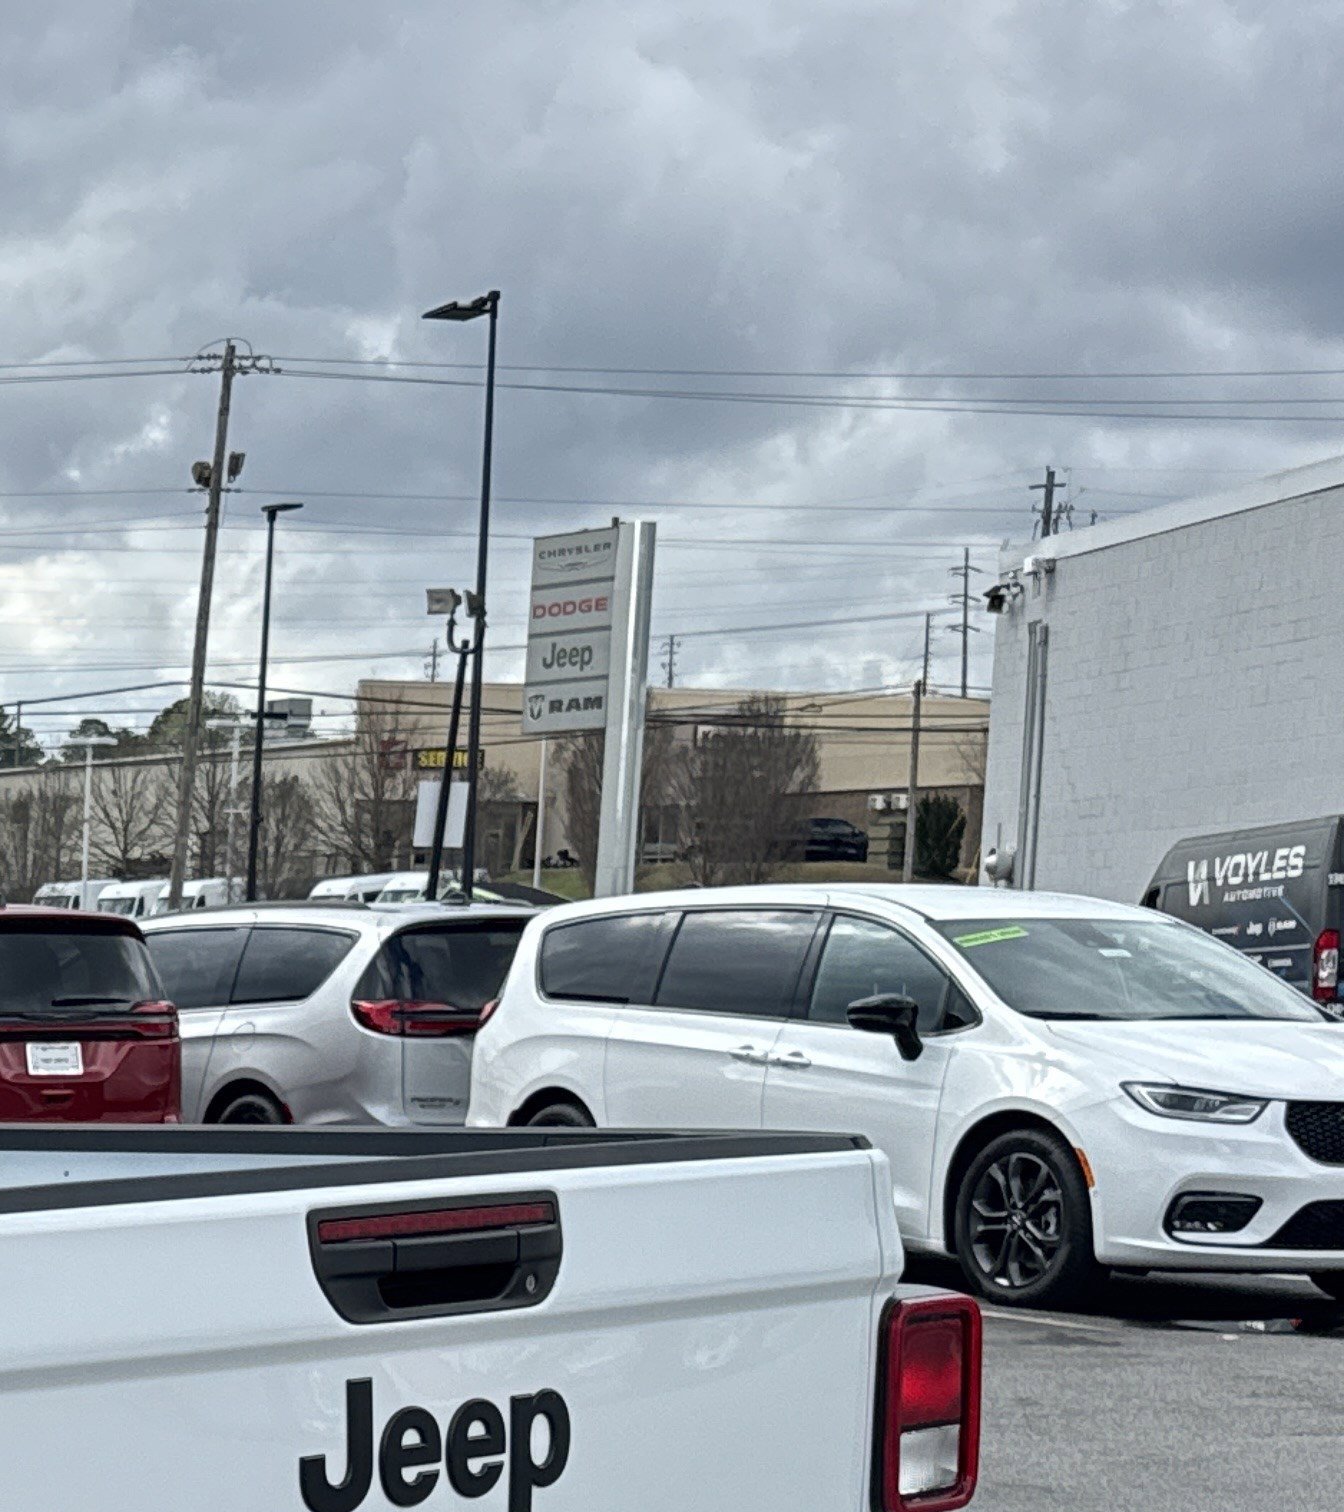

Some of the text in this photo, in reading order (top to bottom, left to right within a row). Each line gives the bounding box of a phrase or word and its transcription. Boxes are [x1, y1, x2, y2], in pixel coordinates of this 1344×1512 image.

[538, 542, 612, 560] CHRYSLER
[532, 597, 609, 620] DODGE
[542, 642, 594, 671] Jeep
[548, 695, 603, 715] RAM
[1214, 845, 1306, 887] VOYLES
